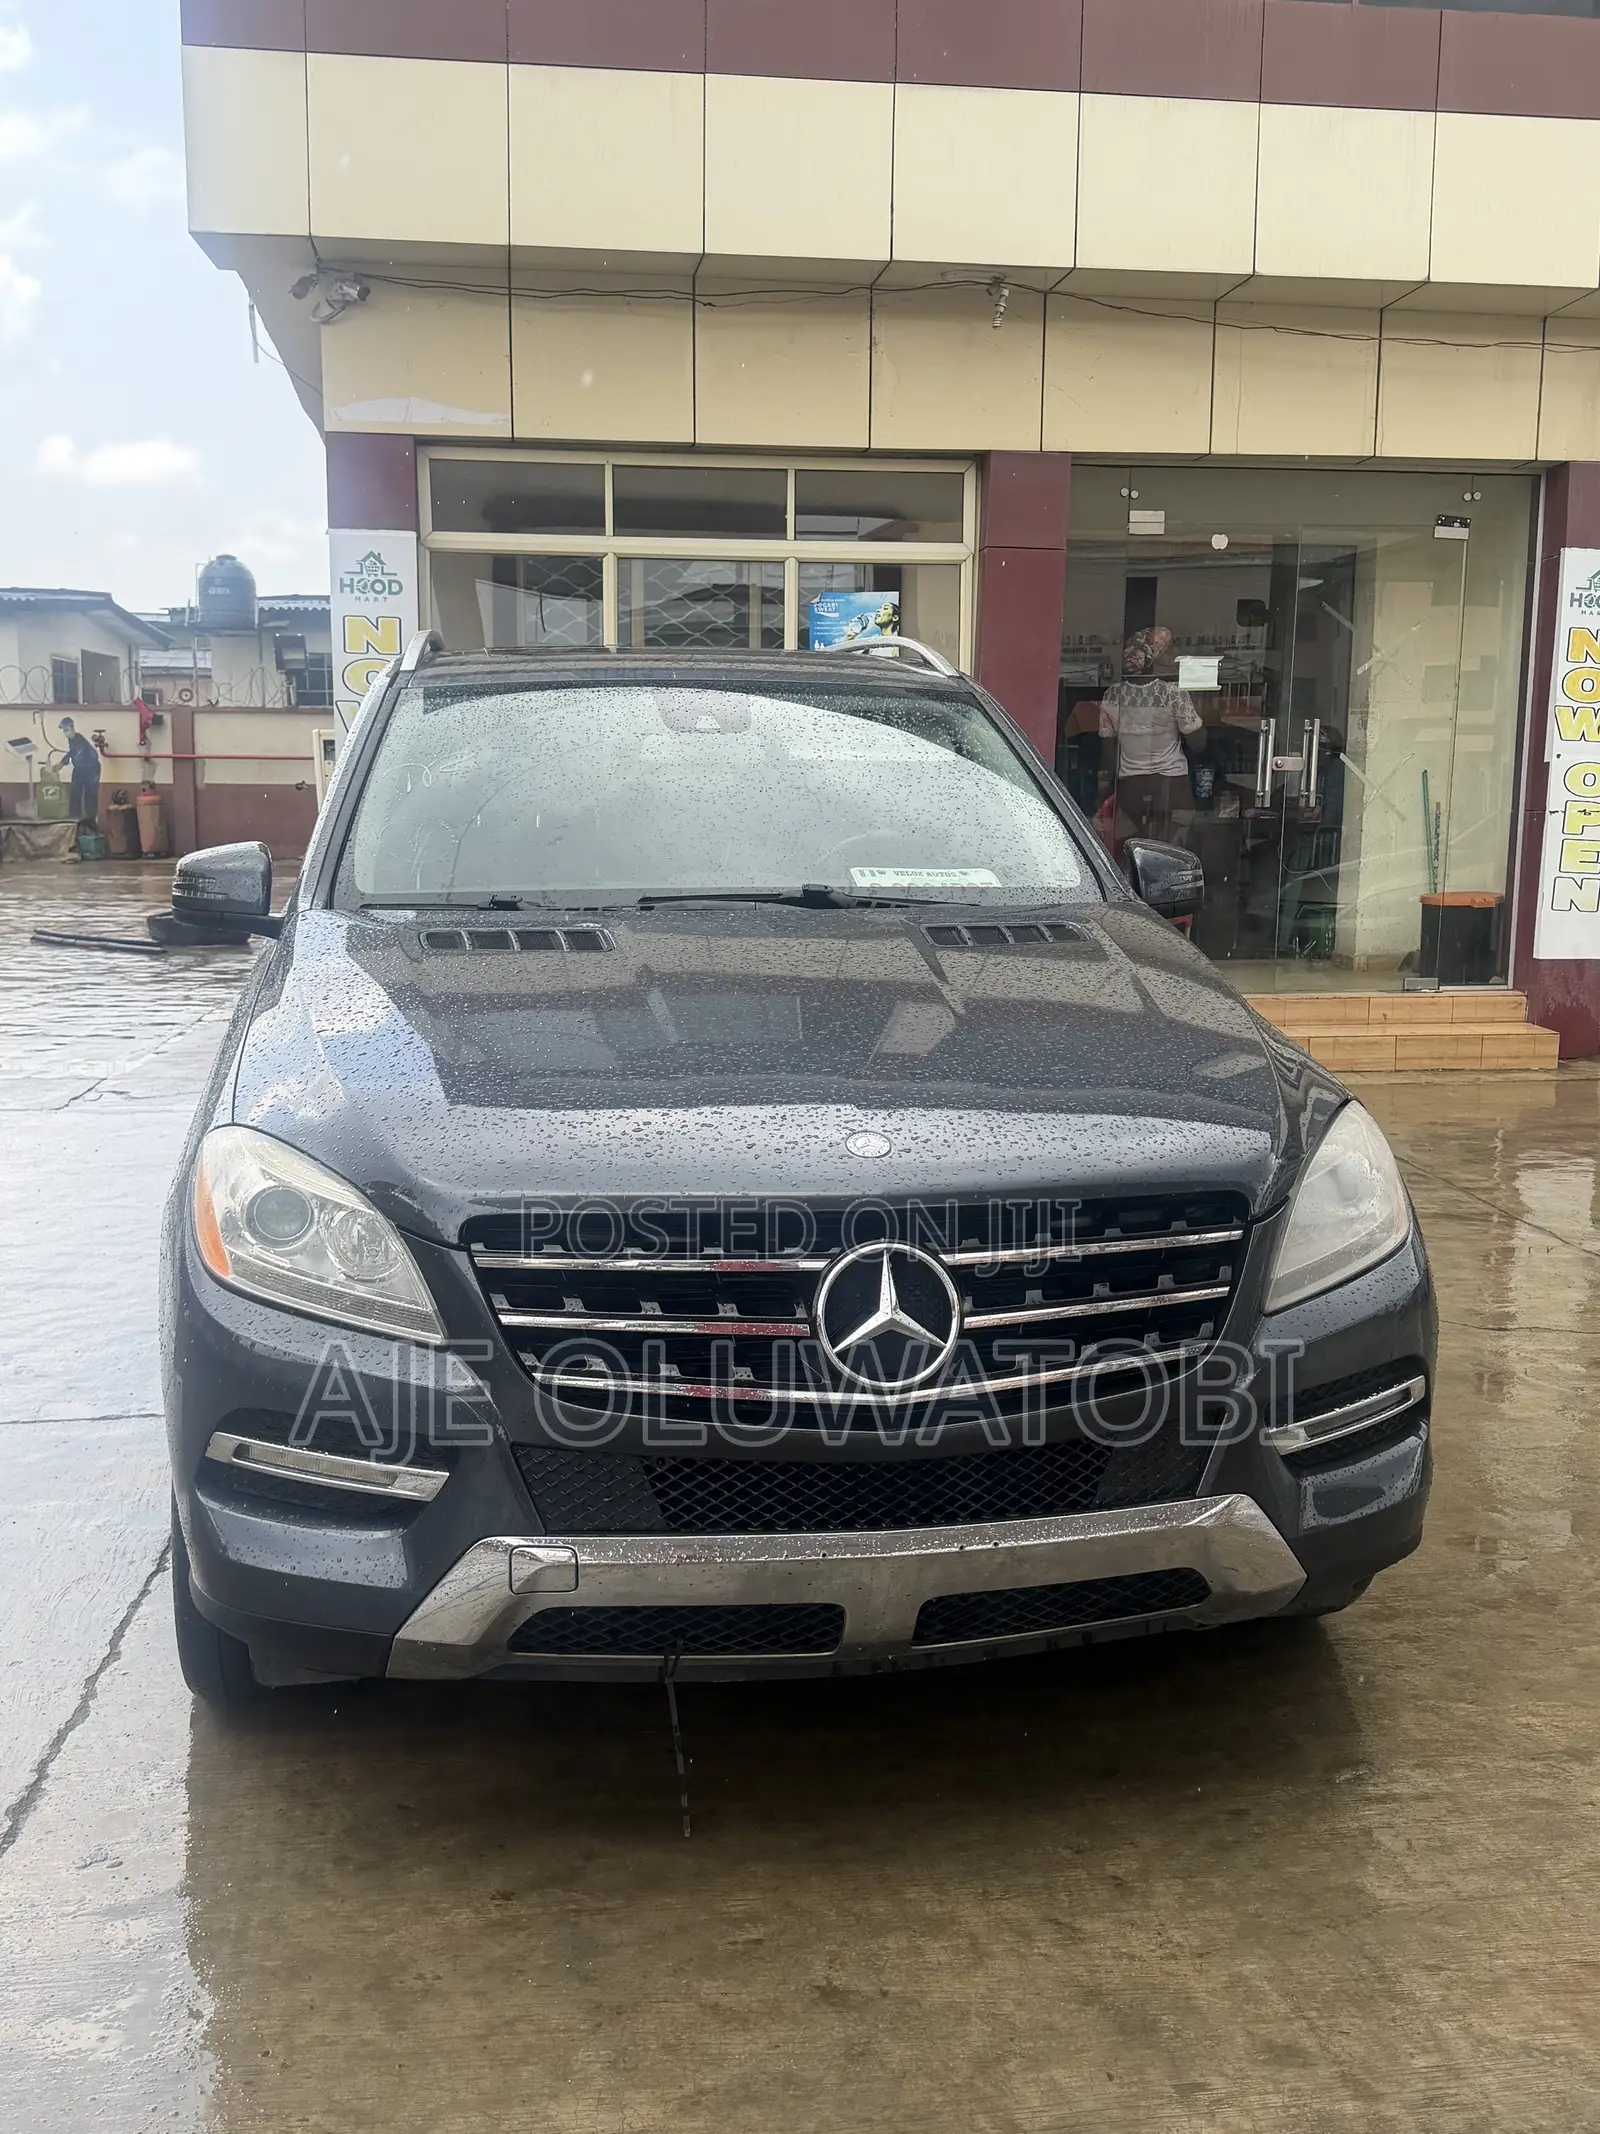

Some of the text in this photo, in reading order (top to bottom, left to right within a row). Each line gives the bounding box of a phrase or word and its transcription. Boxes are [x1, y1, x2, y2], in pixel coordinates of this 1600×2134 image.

[339, 577, 404, 596] HOOD
[354, 595, 389, 603] MART
[1551, 762, 1600, 913] OPEN
